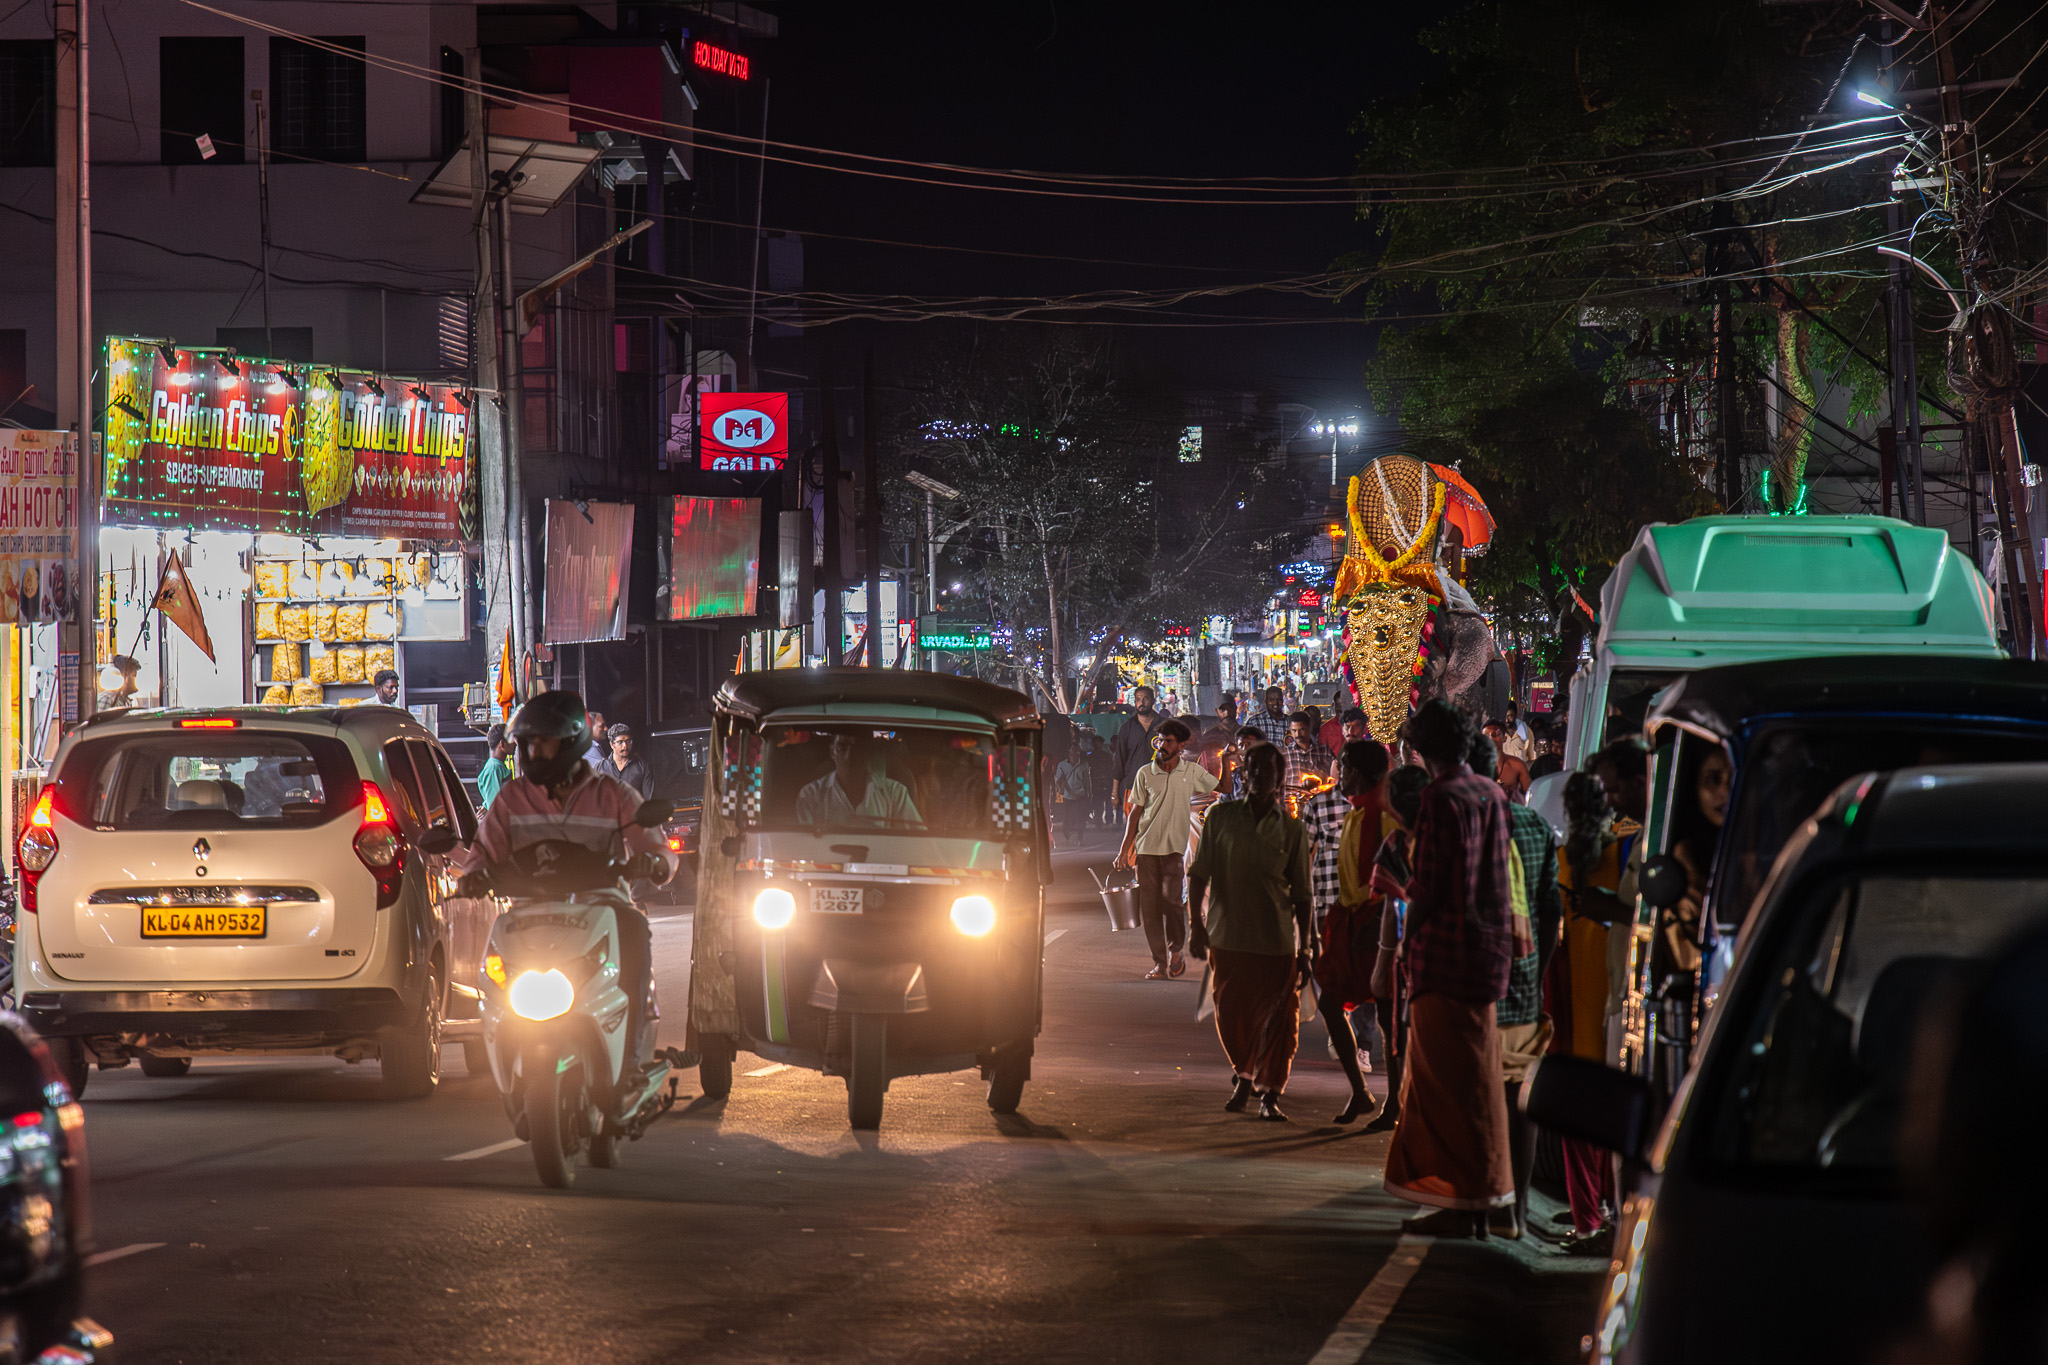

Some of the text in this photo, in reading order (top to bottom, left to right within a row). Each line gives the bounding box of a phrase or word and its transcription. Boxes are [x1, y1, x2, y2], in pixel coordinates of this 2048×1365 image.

[151, 390, 281, 462] Golden Chips
[338, 391, 466, 469] Golden Chips
[167, 461, 265, 489] SPICES SUPERMARKET
[712, 456, 776, 470] GOLD
[24, 487, 51, 528] HOT
[1, 536, 10, 553] HOT
[11, 536, 24, 553] CHIPS
[28, 536, 43, 553] SPICES
[813, 901, 861, 911] 1267
